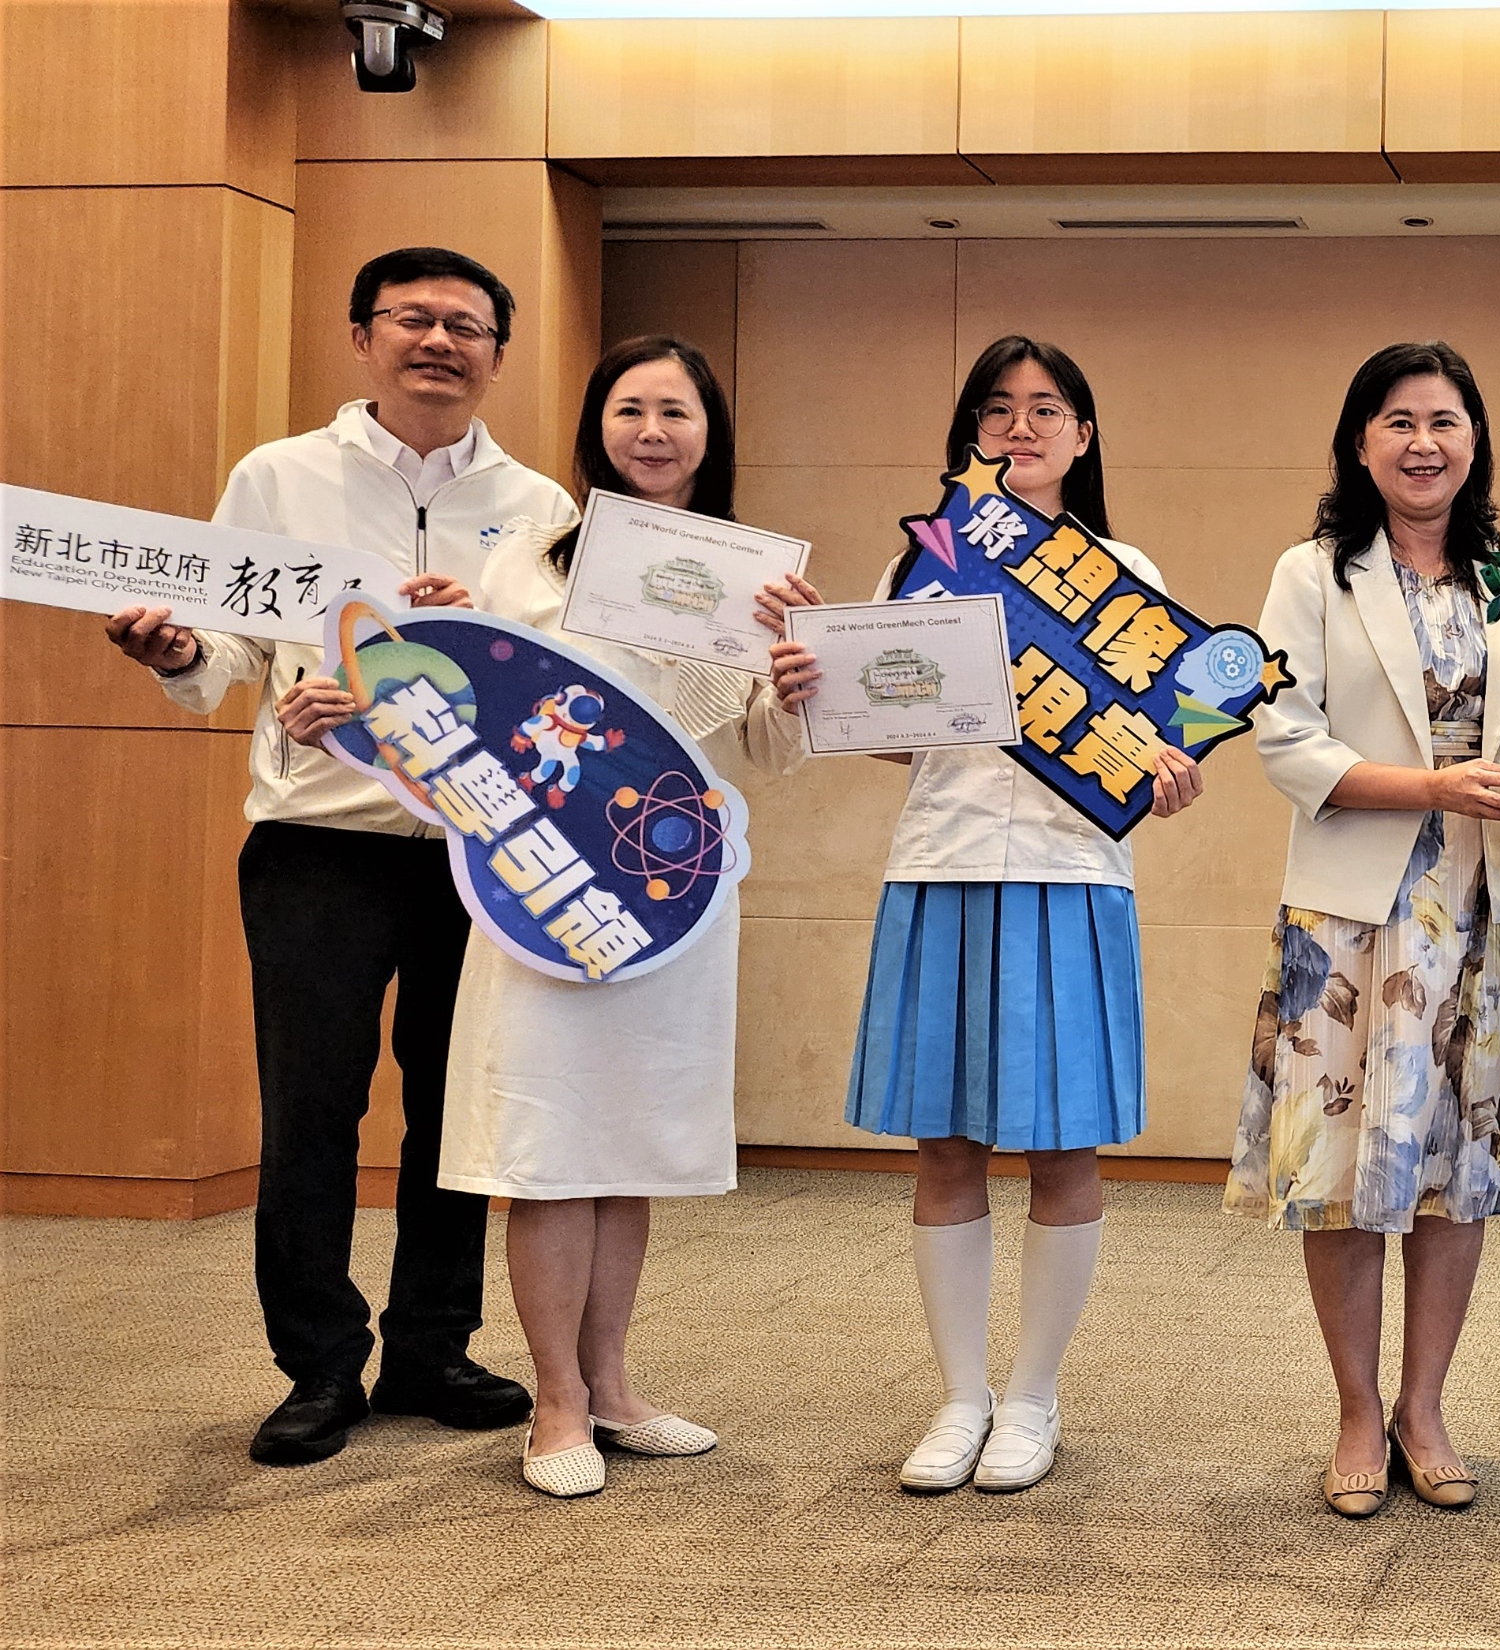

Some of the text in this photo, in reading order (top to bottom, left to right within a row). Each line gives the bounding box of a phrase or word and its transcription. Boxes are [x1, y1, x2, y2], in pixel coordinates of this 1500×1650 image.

[14, 523, 211, 583] 新北市政府
[628, 517, 764, 556] 2024 World GreenMech Contest
[10, 565, 208, 605] New Taipei City Government
[11, 555, 209, 597] Education Department,
[826, 616, 962, 633] 2024 World GreenMech Contest
[364, 676, 655, 981] 科學引領
